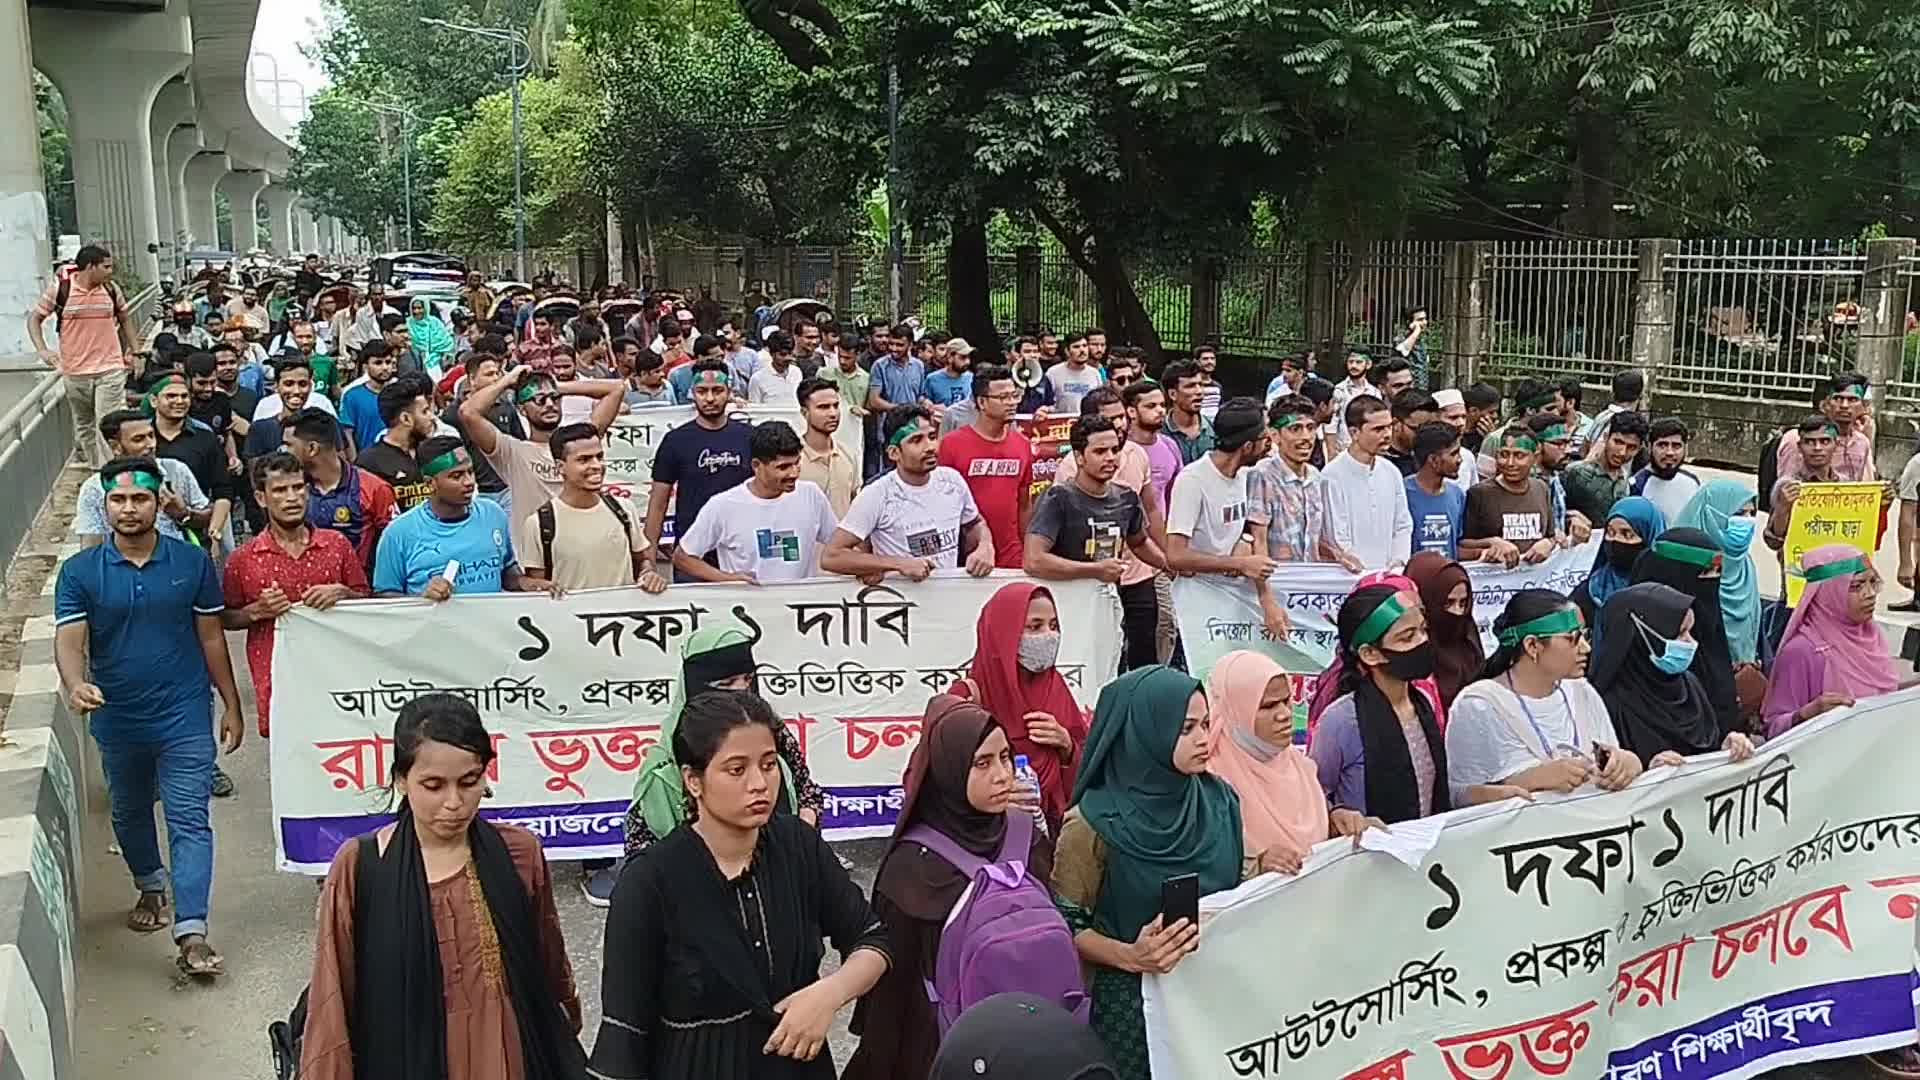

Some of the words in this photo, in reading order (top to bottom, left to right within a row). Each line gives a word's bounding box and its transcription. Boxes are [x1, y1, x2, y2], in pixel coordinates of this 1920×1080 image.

[1502, 513, 1541, 526] HEAVY
[1503, 526, 1543, 540] METAL
[1804, 514, 1838, 537] পরীক্ষা
[1841, 519, 1862, 539] ছাড়া
[518, 616, 550, 661] ১
[576, 602, 709, 657] দফা
[787, 585, 918, 647] দাবি
[583, 677, 676, 706] প্রকল্প
[1427, 863, 1461, 930] ১
[1489, 815, 1646, 907] দফা
[1653, 808, 1684, 867] ১
[1704, 753, 1795, 844] দাবি
[1226, 951, 1489, 1078] আউটসোর্সিং,
[1505, 928, 1612, 988] প্রকল্প
[1631, 856, 1781, 941] চুক্তিভিত্তিক
[1710, 884, 1853, 980] চলবে
[1672, 999, 1836, 1072] শিক্ষার্থীবৃন্দ
